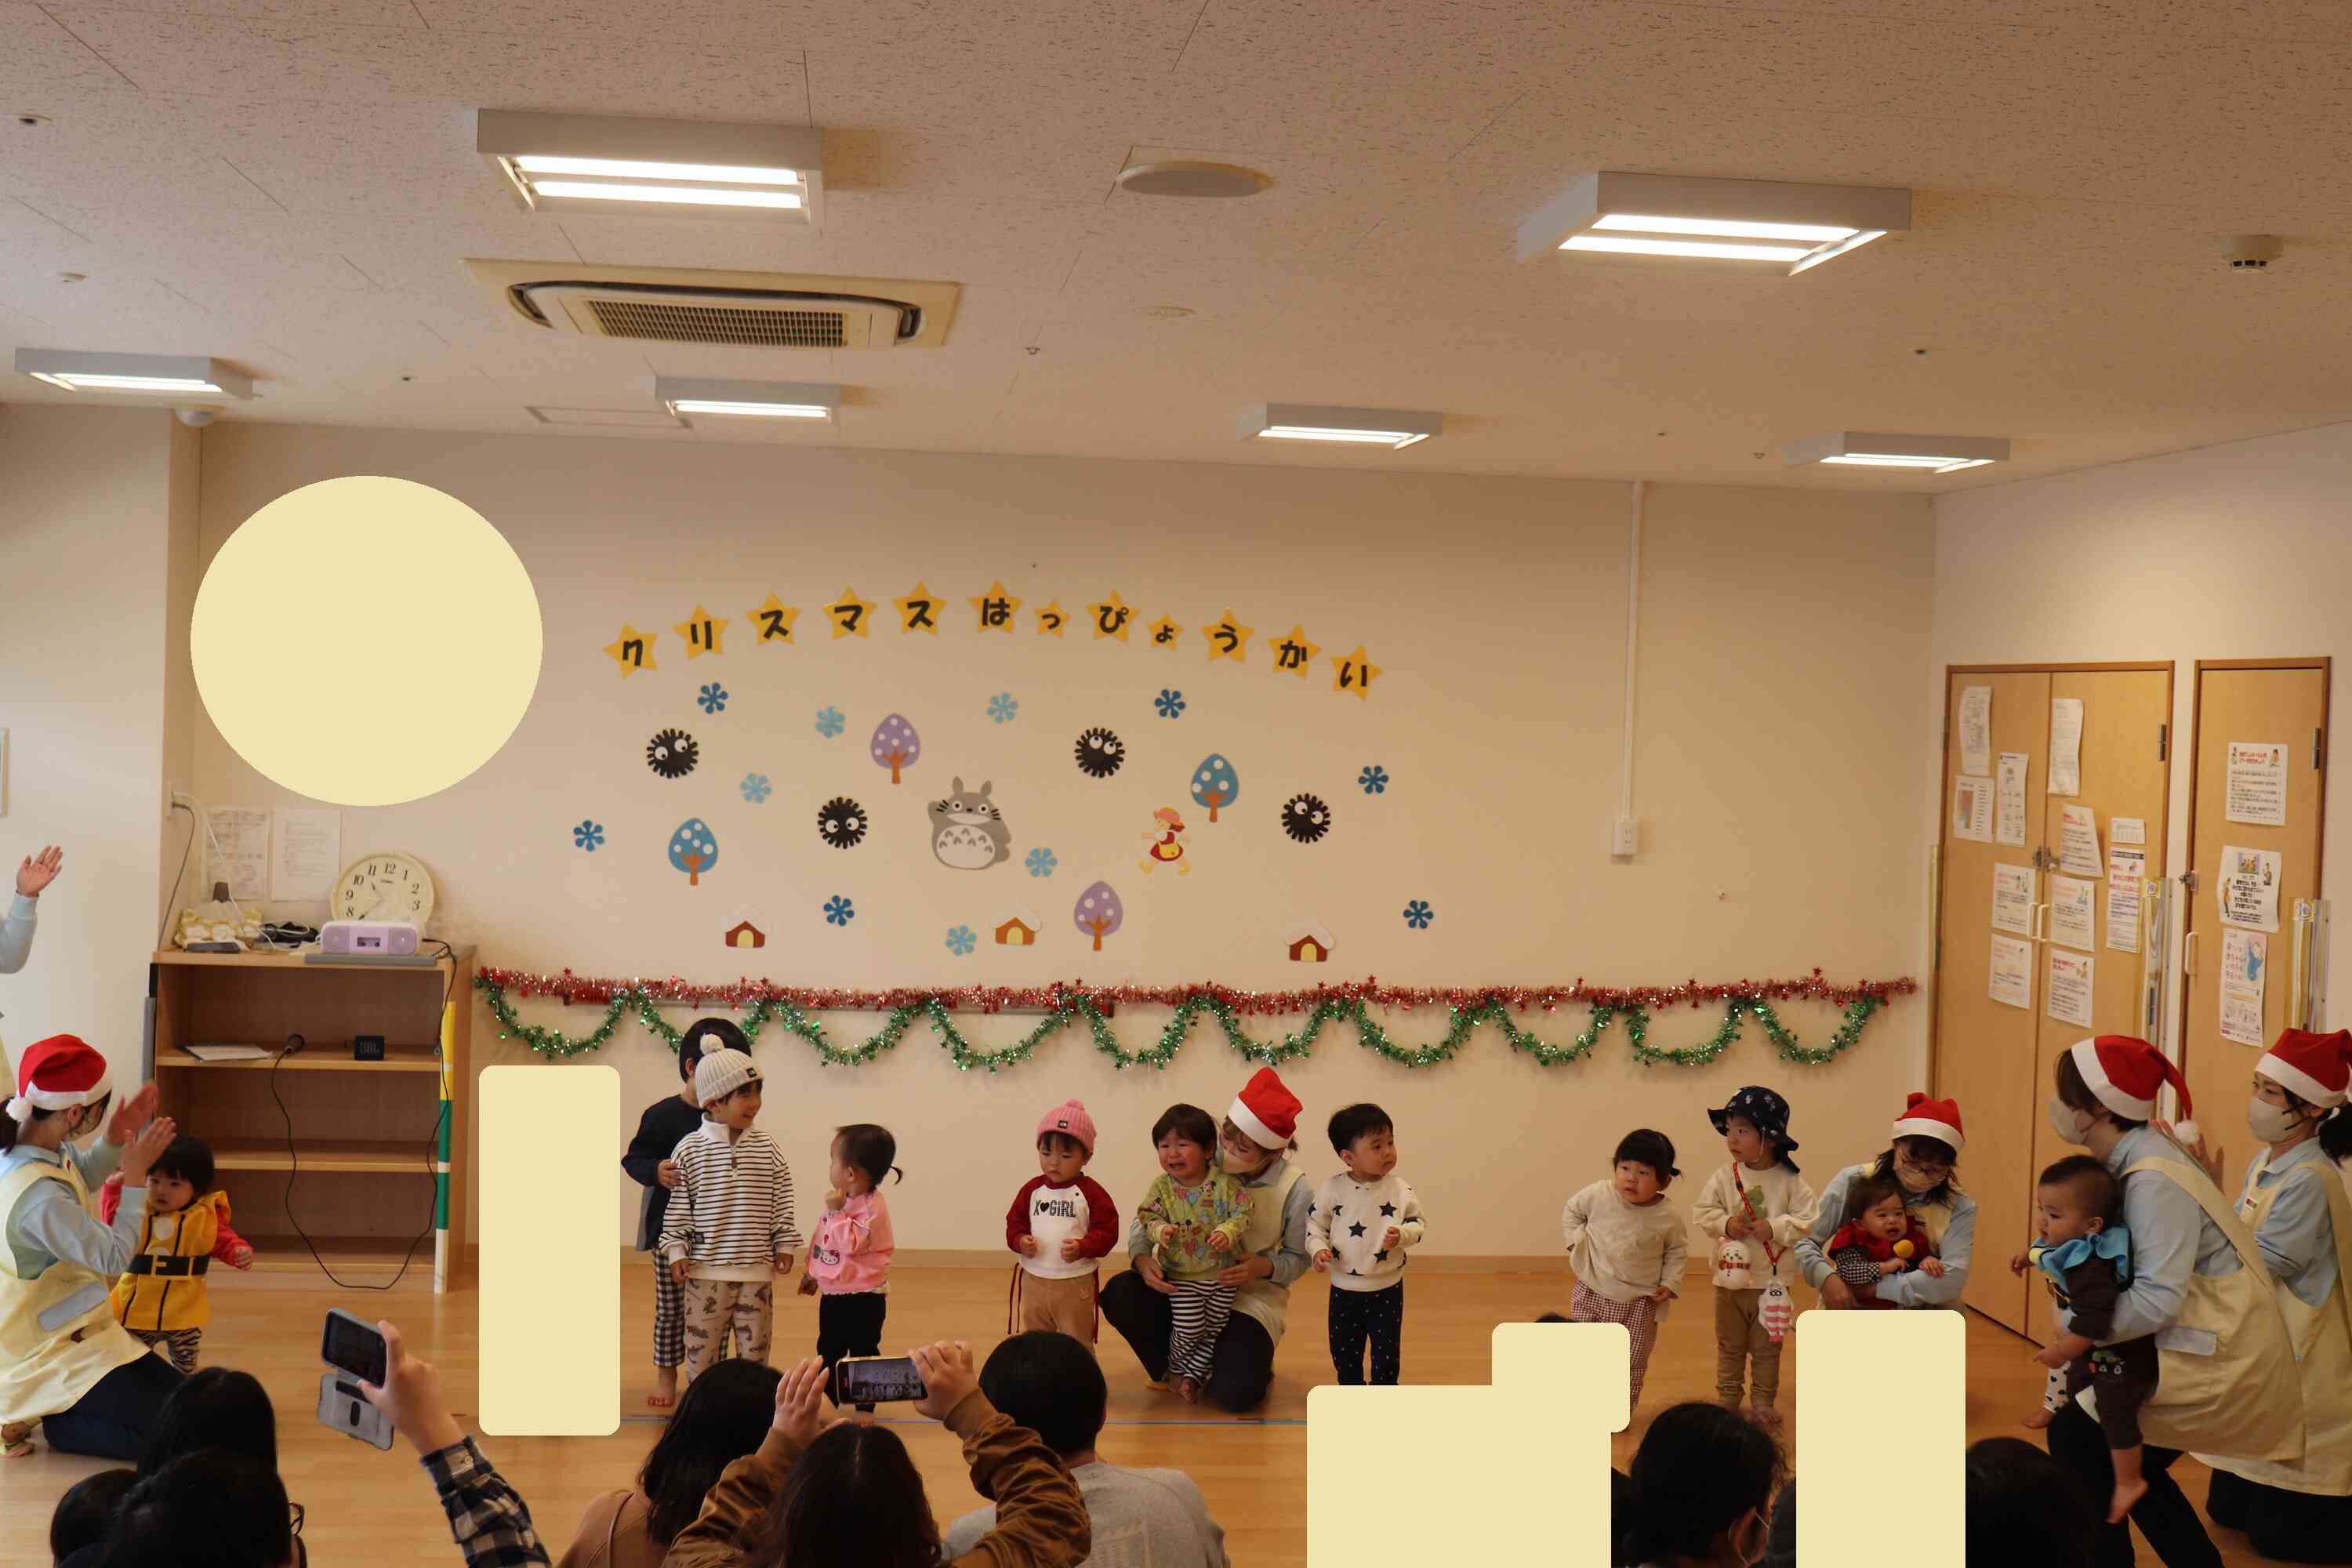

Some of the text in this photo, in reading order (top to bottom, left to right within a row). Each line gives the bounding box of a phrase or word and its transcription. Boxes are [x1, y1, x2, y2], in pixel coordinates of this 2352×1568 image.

[368, 864, 377, 876] 11
[383, 862, 396, 875] 12
[354, 874, 365, 885] 10
[402, 869, 408, 880] 1
[412, 883, 420, 895] 2
[345, 890, 354, 901] 9
[412, 900, 421, 911] 3
[346, 906, 354, 917] 8
